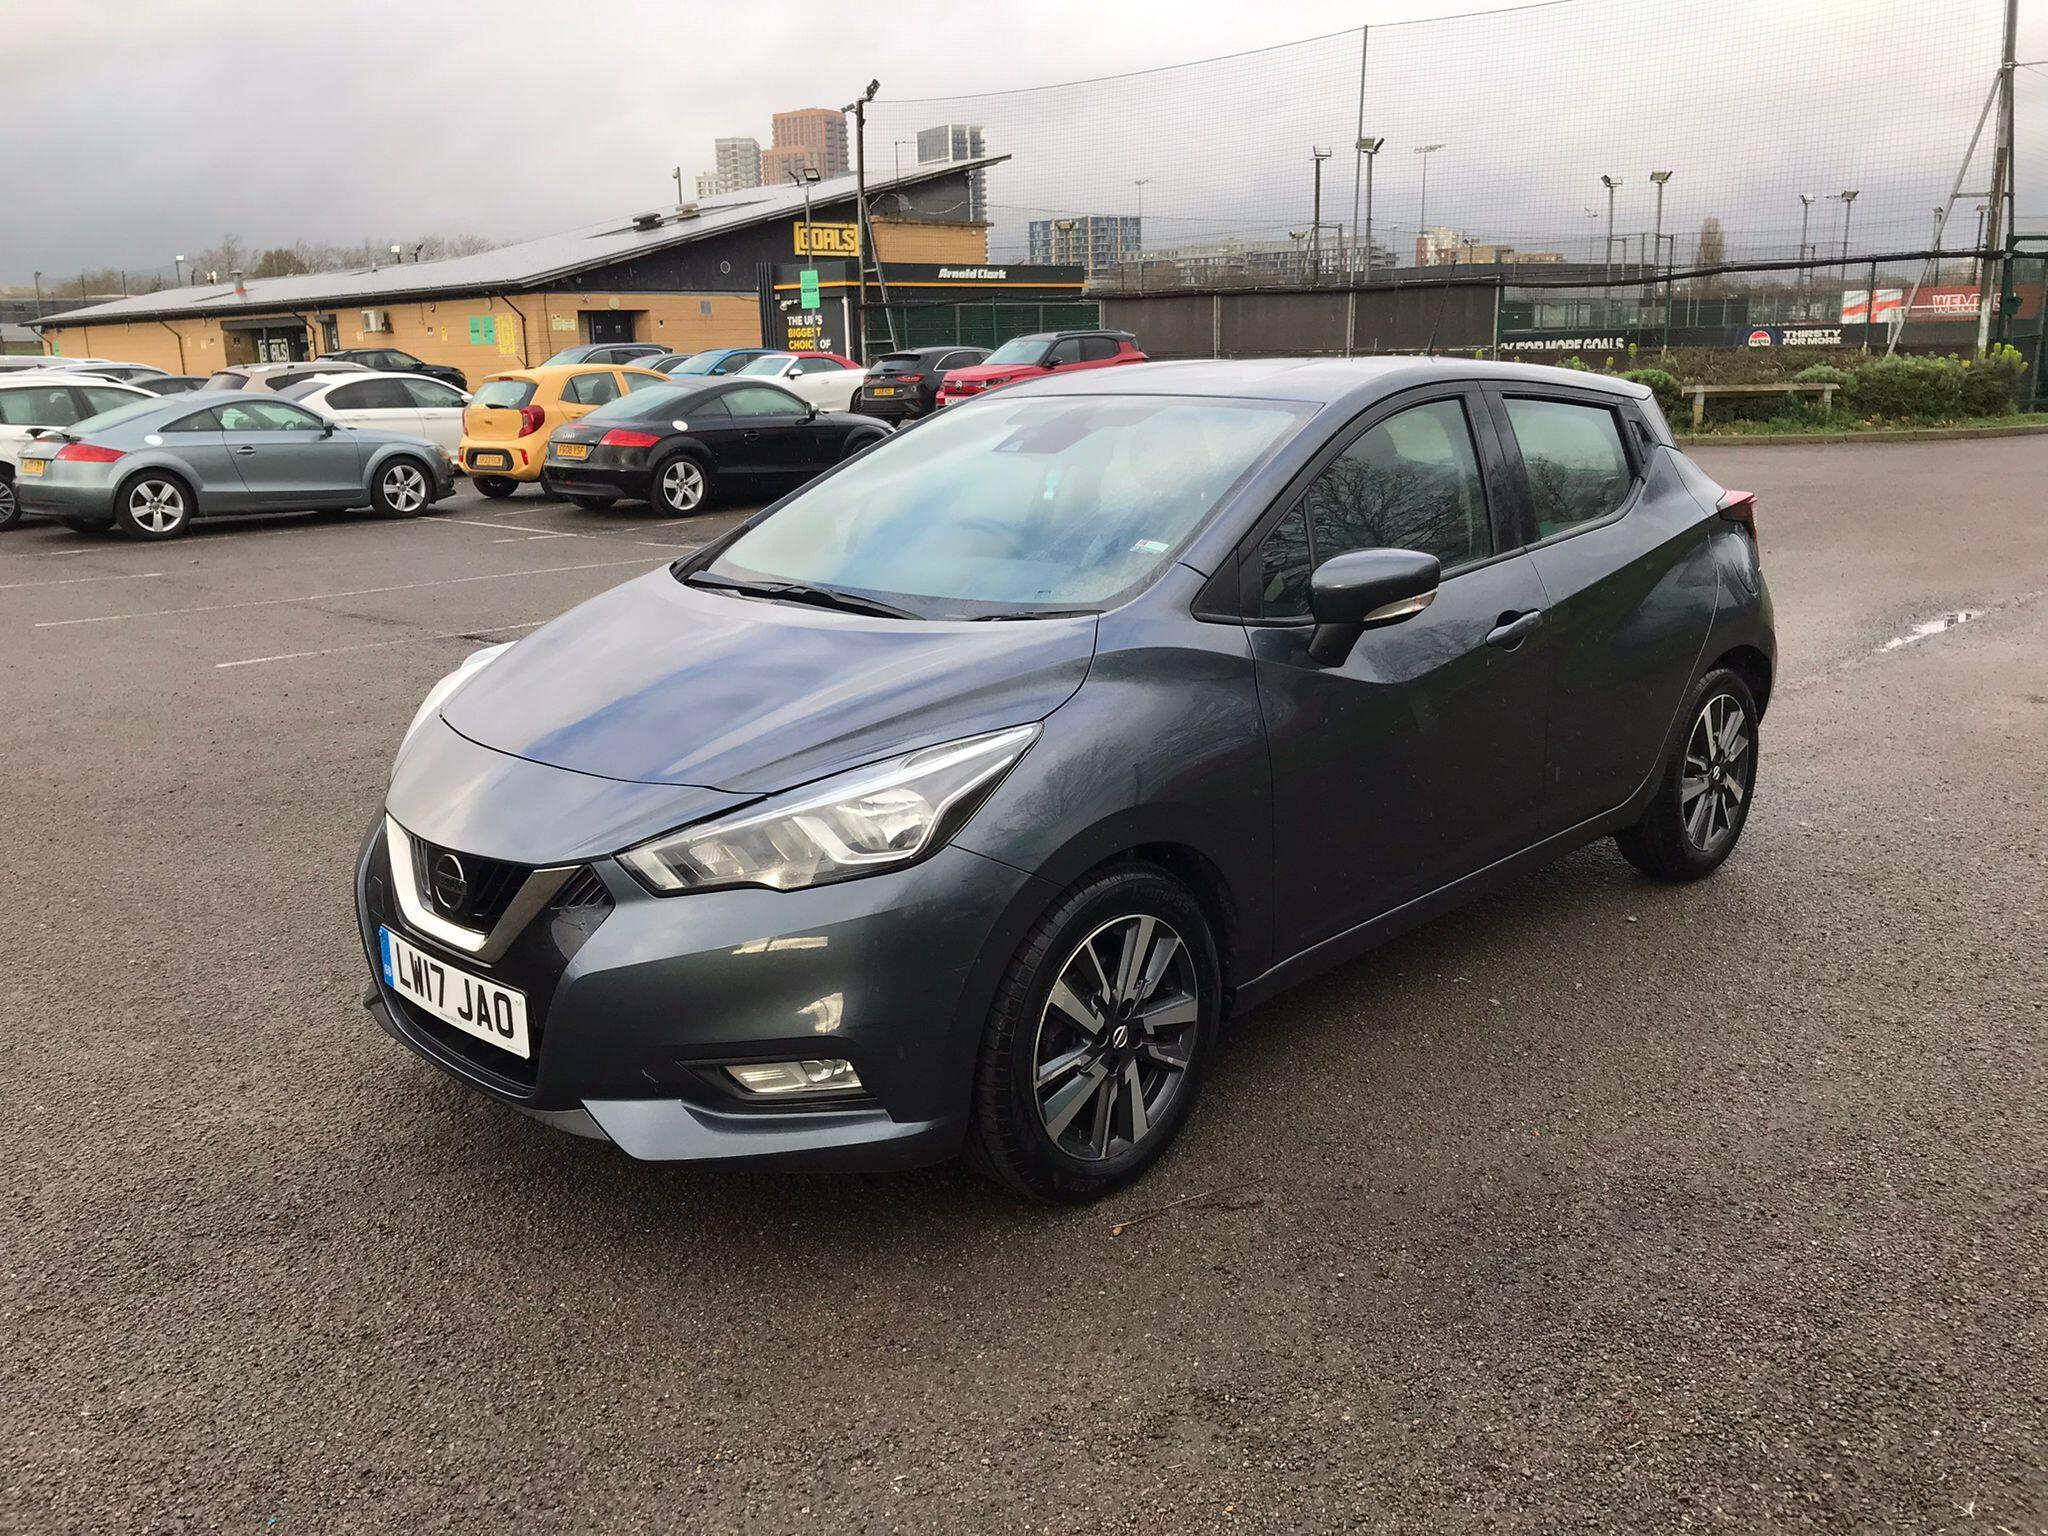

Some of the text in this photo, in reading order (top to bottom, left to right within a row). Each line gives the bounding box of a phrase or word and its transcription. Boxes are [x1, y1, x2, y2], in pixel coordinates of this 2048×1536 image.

[800, 228, 855, 250] GOALS
[938, 268, 1006, 279] Arnold Clark
[787, 316, 803, 326] THE
[788, 327, 822, 338] BIGGET
[1783, 329, 1841, 338] THIRSTY
[789, 339, 831, 350] CHOIC OF
[1583, 338, 1624, 349] GOALS
[261, 343, 288, 361] GALS
[395, 942, 514, 1039] LW17 JAO
